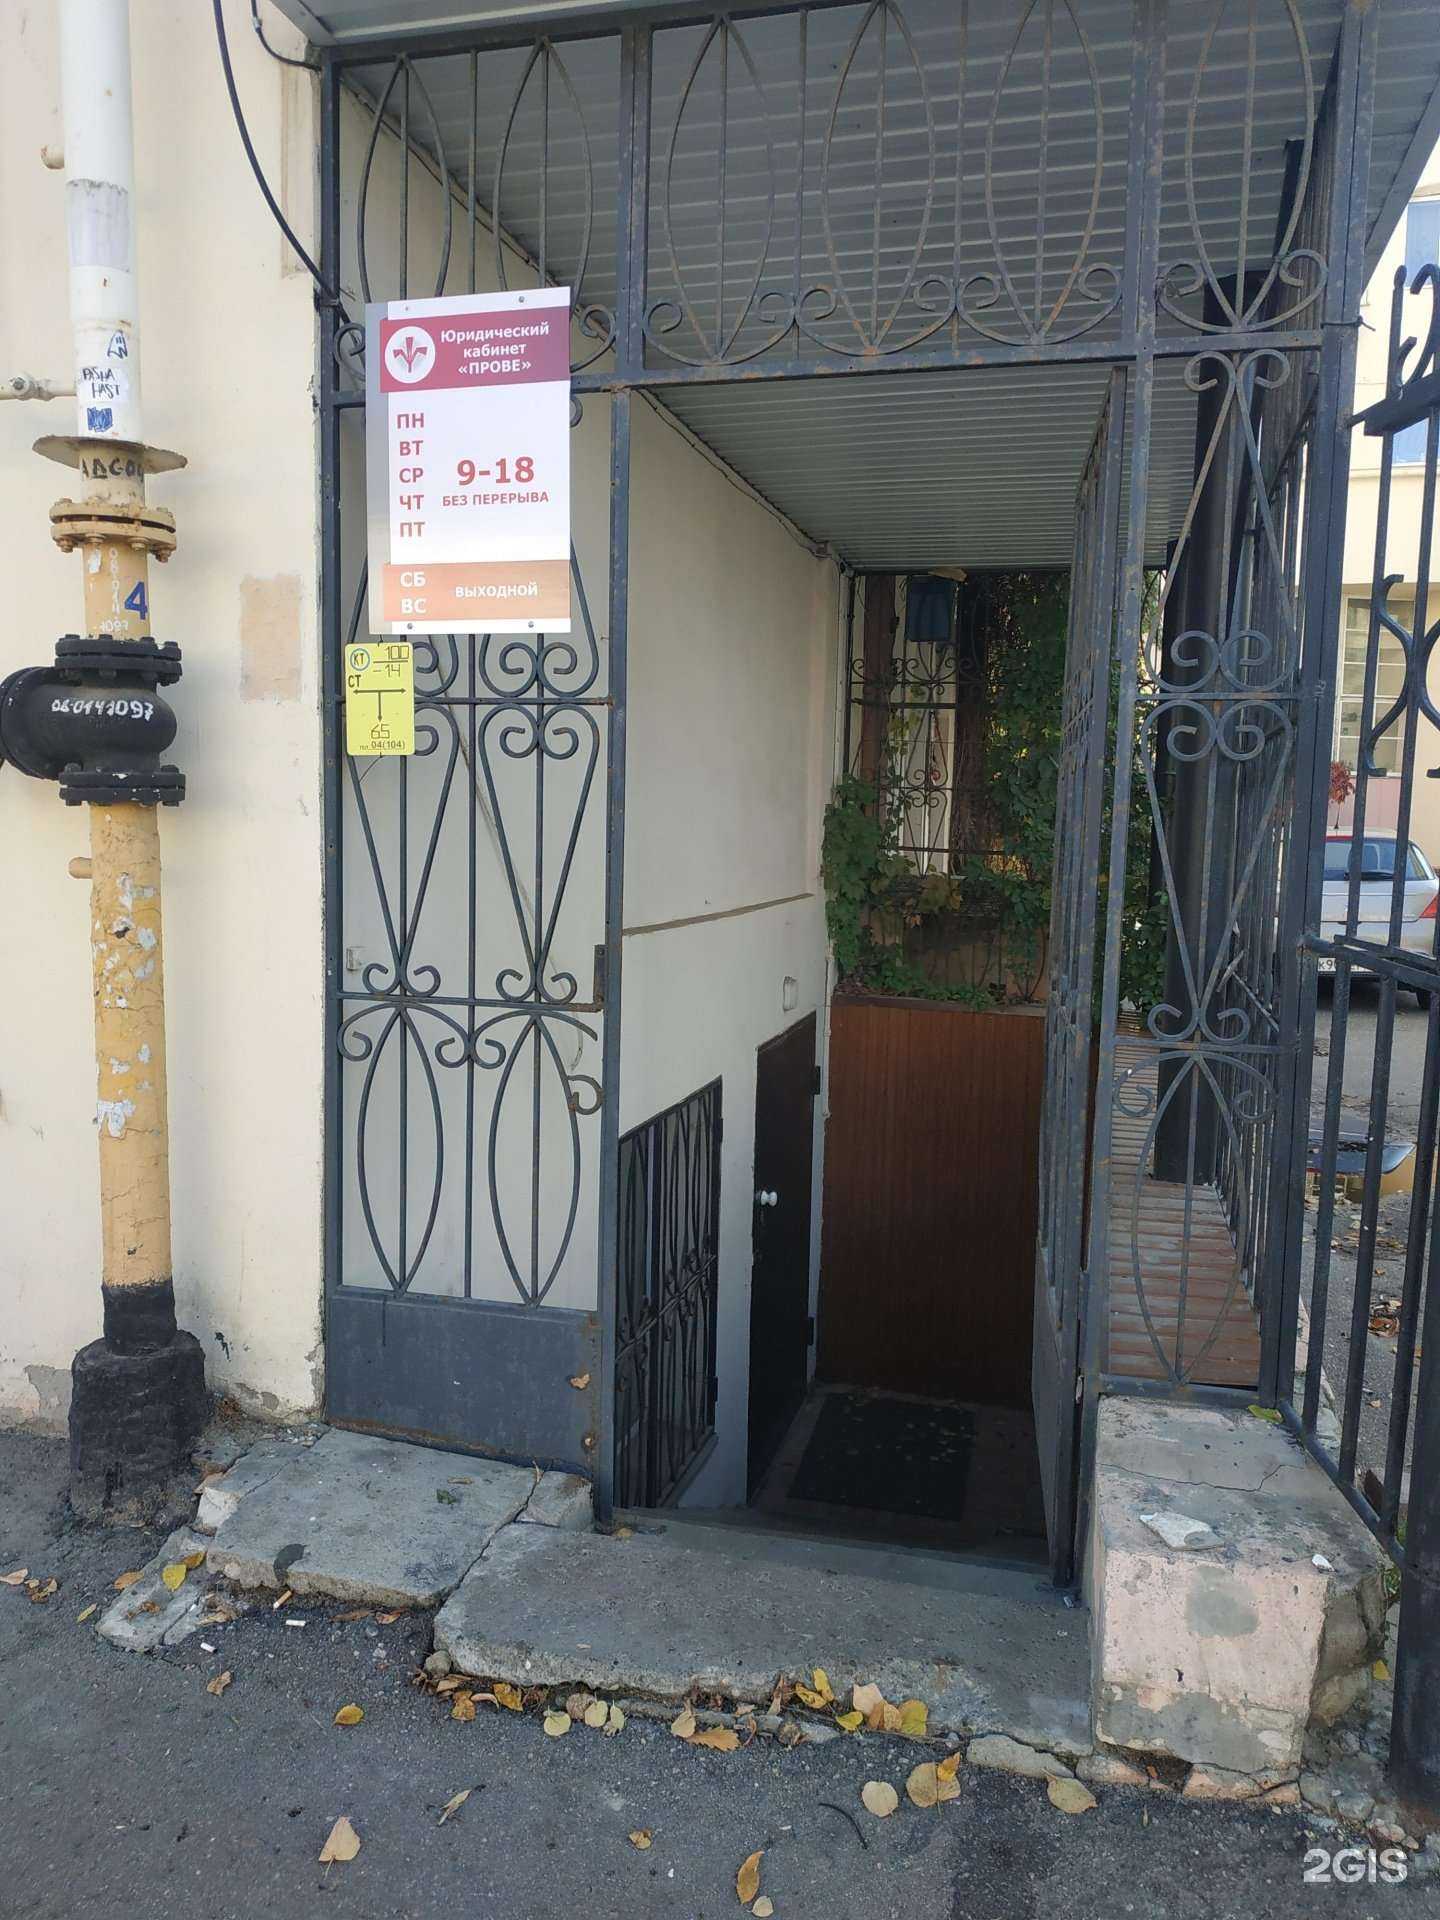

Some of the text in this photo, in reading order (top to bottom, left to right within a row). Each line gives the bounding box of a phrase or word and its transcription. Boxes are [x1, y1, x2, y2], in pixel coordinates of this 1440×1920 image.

[441, 321, 549, 344] Юридический
[463, 343, 527, 359] кабинет
[458, 359, 532, 375] «ПРОВЕ»
[396, 412, 425, 429] ПН
[399, 440, 424, 456] ВТ
[398, 467, 424, 484] СР
[456, 456, 535, 486] 9-18
[399, 494, 425, 510] ЧТ
[442, 491, 549, 507] БЕЗ ПЕРЕРЫВА
[399, 521, 426, 537] ПТ
[400, 571, 426, 588] СБ
[124, 580, 148, 621] 4
[400, 597, 427, 614] ВС
[347, 674, 362, 688] СТ
[370, 723, 391, 740] 65
